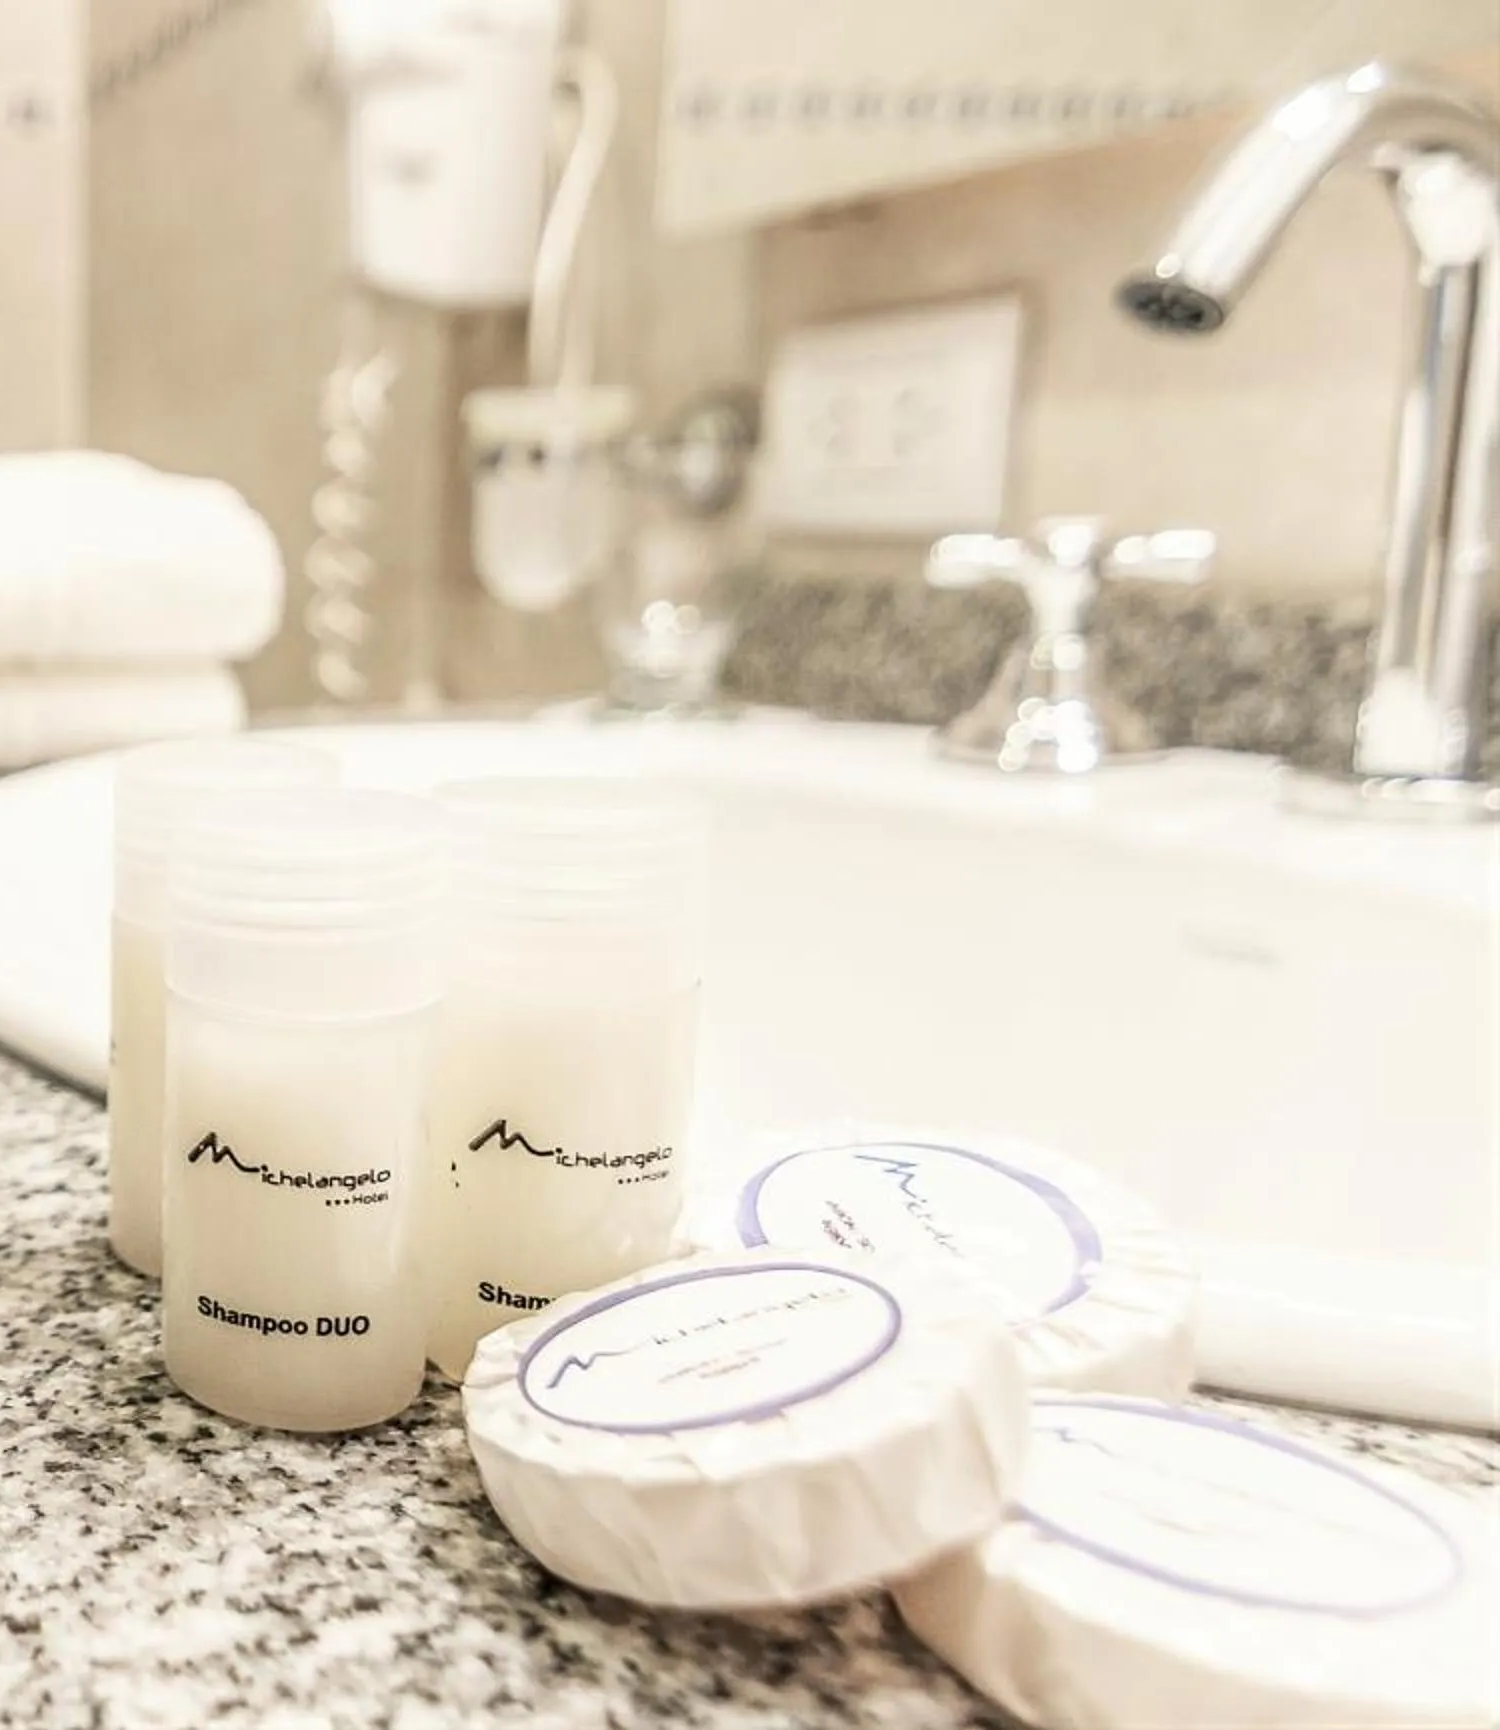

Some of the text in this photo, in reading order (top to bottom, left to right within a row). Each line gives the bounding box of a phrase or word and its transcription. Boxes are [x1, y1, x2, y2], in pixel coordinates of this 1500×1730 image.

[188, 1131, 391, 1191] Michelangelo
[468, 1119, 673, 1168] Michelangelo
[197, 1295, 370, 1336] Shampoo DUO
[478, 1281, 557, 1311] Sham
